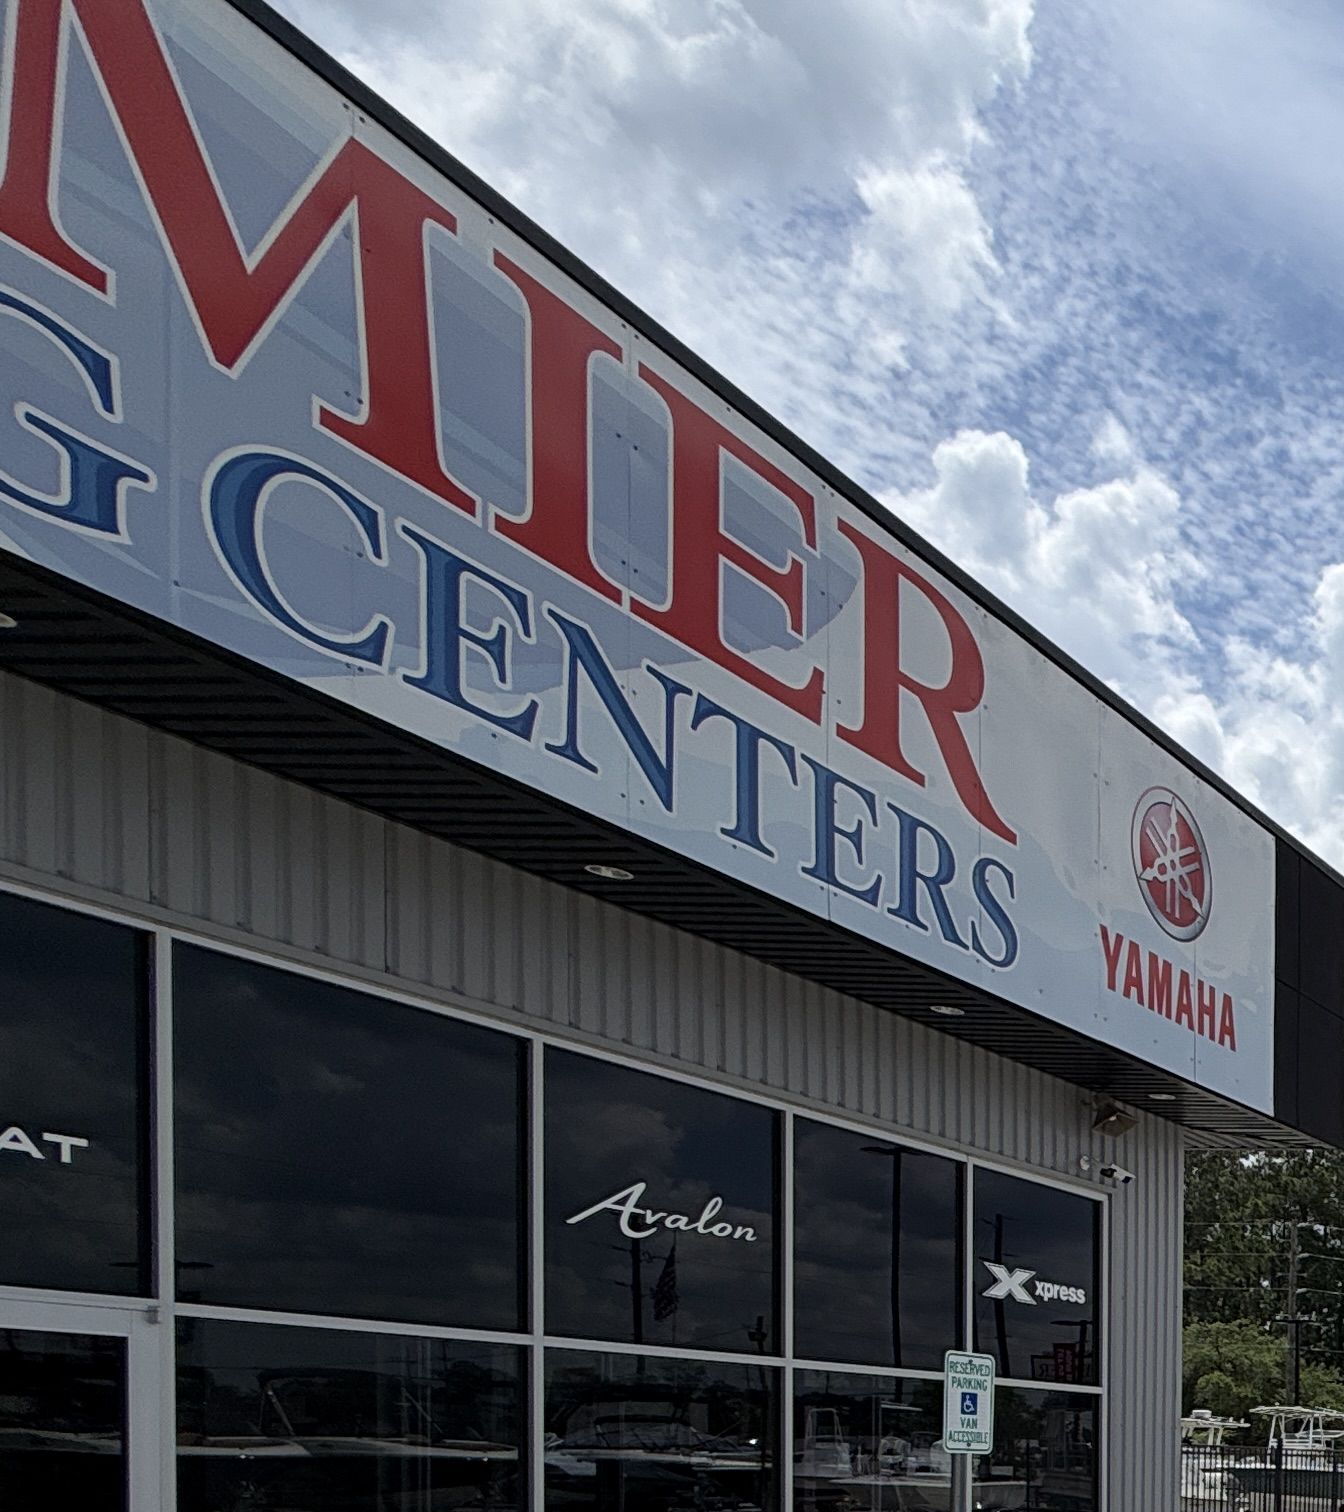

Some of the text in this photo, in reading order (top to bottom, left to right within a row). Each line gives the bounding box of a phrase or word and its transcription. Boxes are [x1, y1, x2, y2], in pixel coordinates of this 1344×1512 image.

[203, 447, 1018, 969] CENTERS
[1099, 923, 1237, 1053] YAMAHA
[566, 1181, 757, 1242] Avalon
[949, 1361, 991, 1377] RESERVED
[951, 1376, 988, 1391] PARKING
[960, 1417, 978, 1430] VAN
[948, 1430, 989, 1444] ACCESSIBLE
